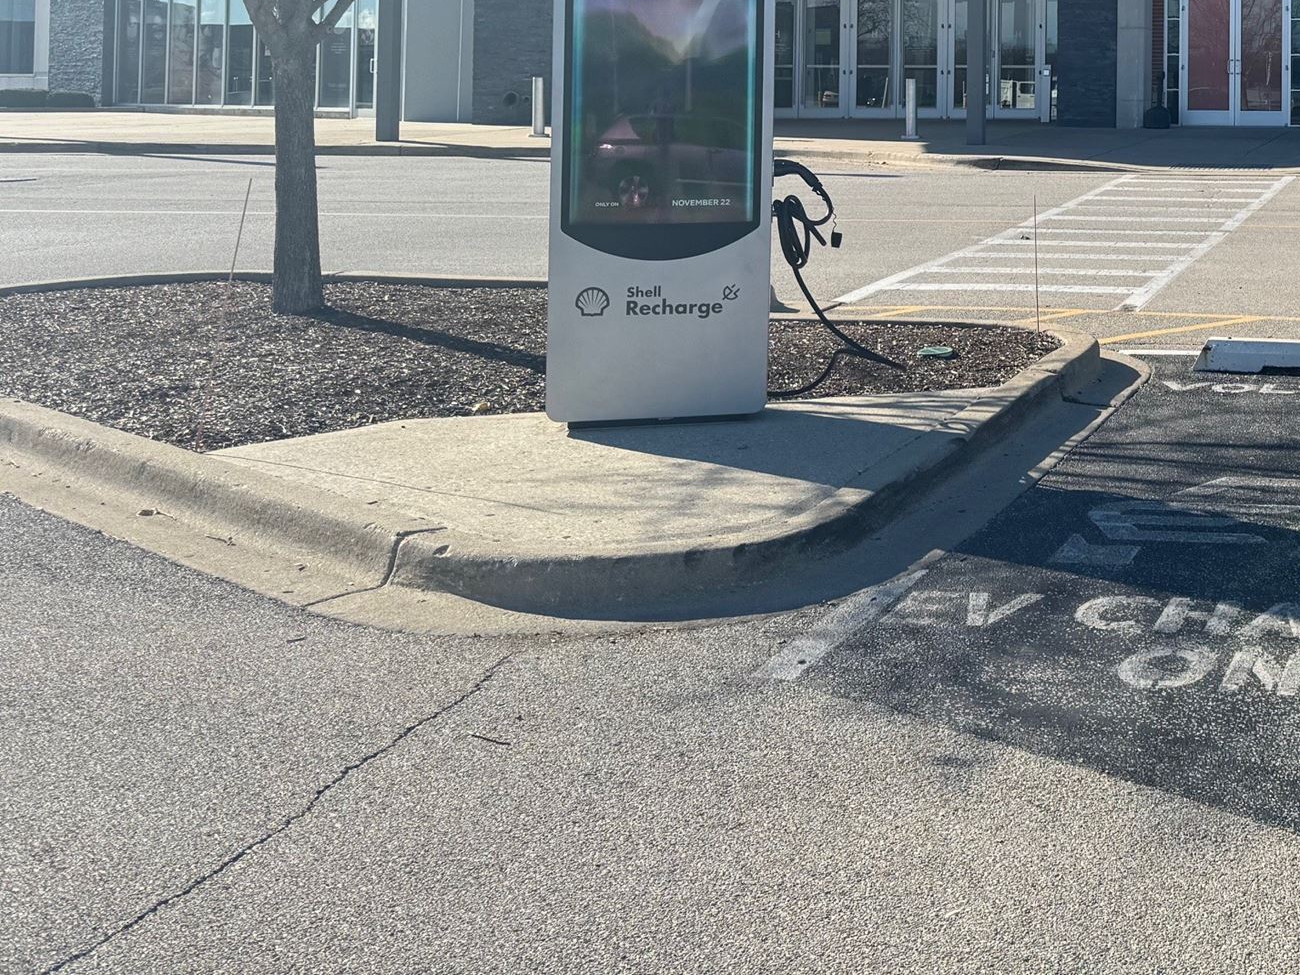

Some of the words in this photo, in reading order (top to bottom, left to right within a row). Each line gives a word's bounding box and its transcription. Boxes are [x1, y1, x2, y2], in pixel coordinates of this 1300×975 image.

[671, 199, 719, 207] NOVEMBER
[720, 198, 731, 206] 22
[626, 285, 662, 298] Shell
[625, 298, 724, 319] Recharge
[880, 590, 1045, 627] EV
